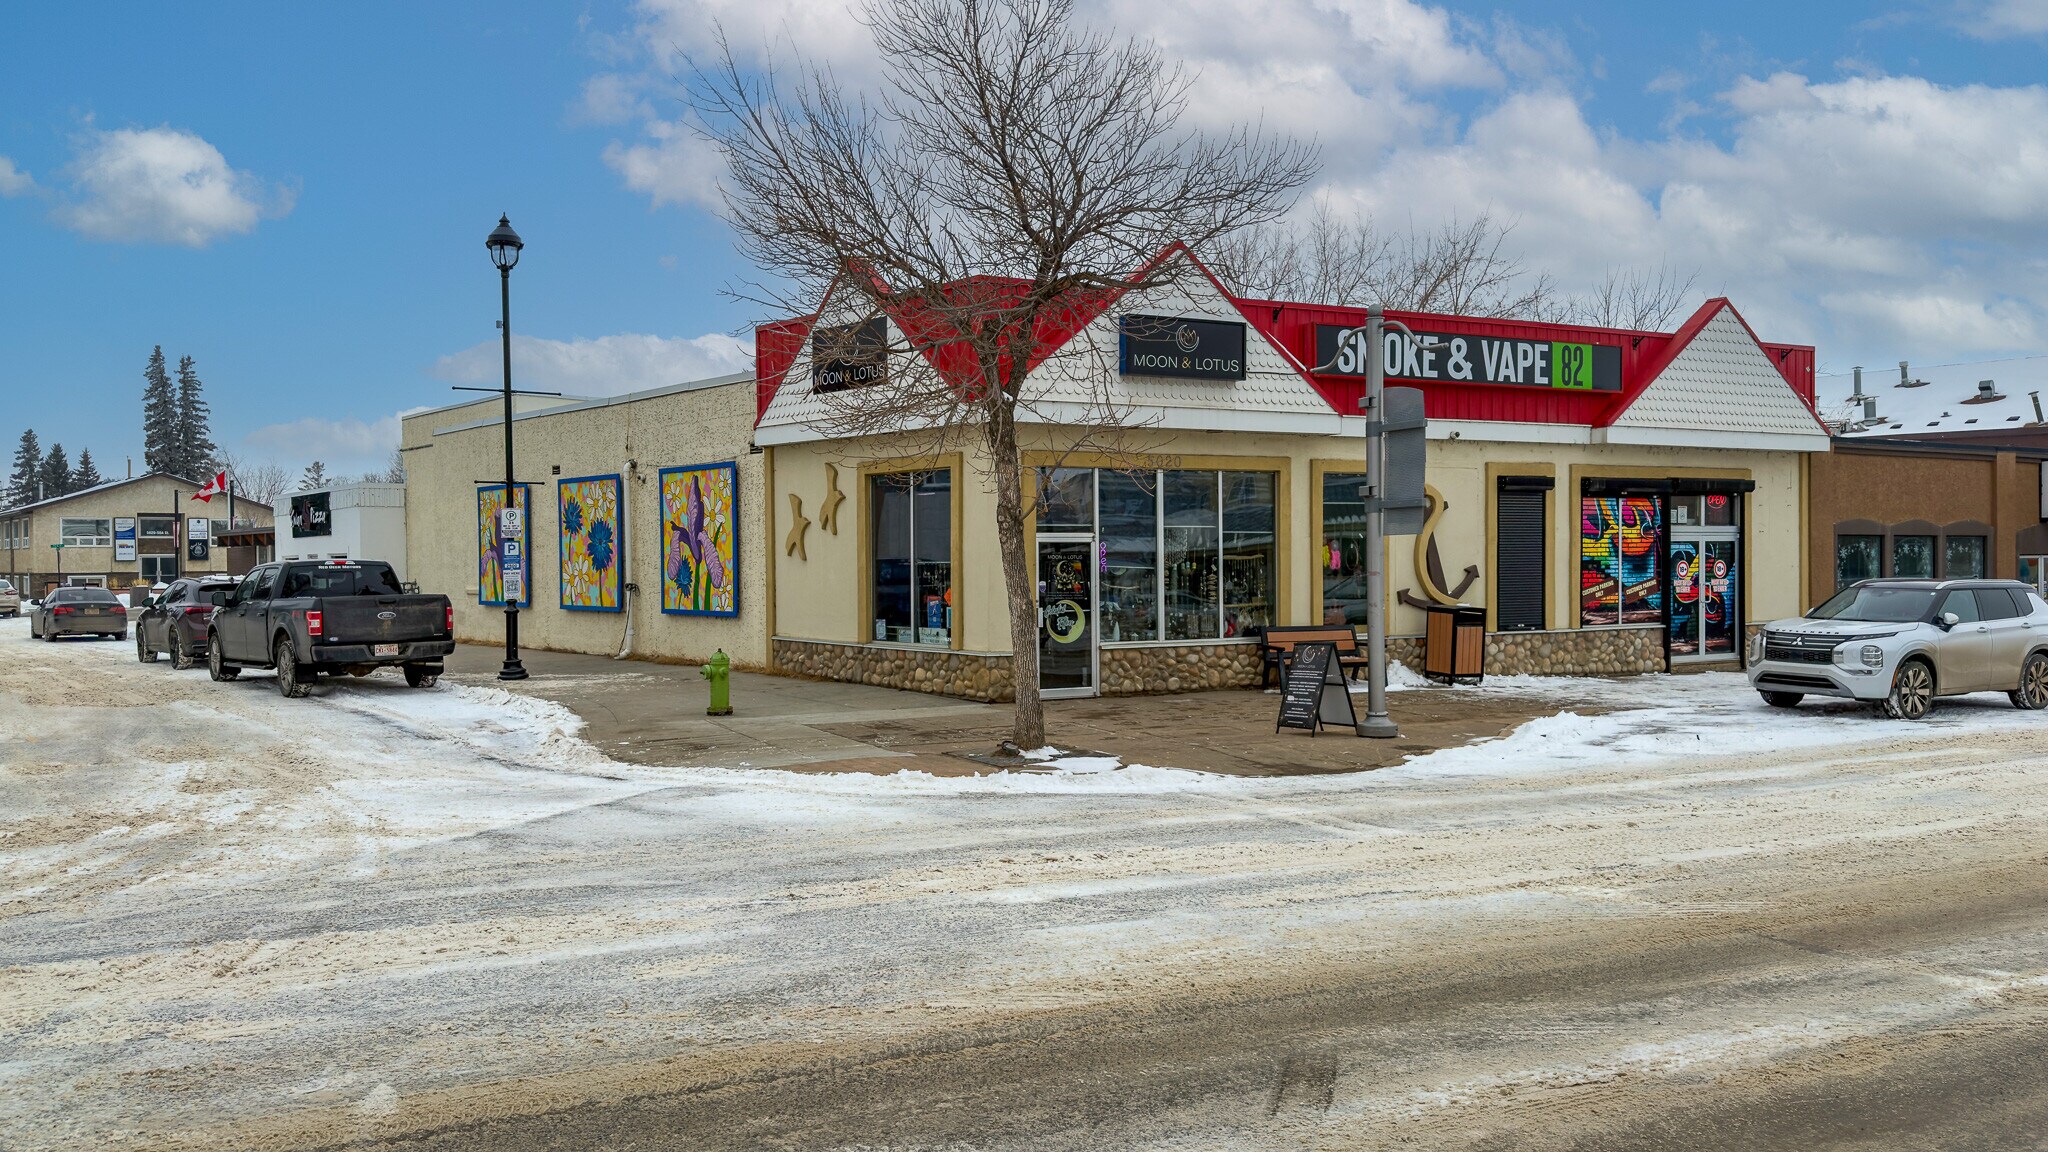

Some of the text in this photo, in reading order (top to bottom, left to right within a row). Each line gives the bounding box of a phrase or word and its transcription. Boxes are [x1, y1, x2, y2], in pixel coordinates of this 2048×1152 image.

[1133, 355, 1240, 372] MOON & LOTUS
[1447, 337, 1473, 380] &
[1481, 340, 1548, 385] VAPE
[1561, 345, 1584, 387] 82
[854, 364, 886, 381] LOTUS
[1707, 496, 1726, 505] OPEN
[508, 544, 516, 554] P
[1600, 580, 1614, 589] PARKING
[1642, 579, 1657, 588] PARKING
